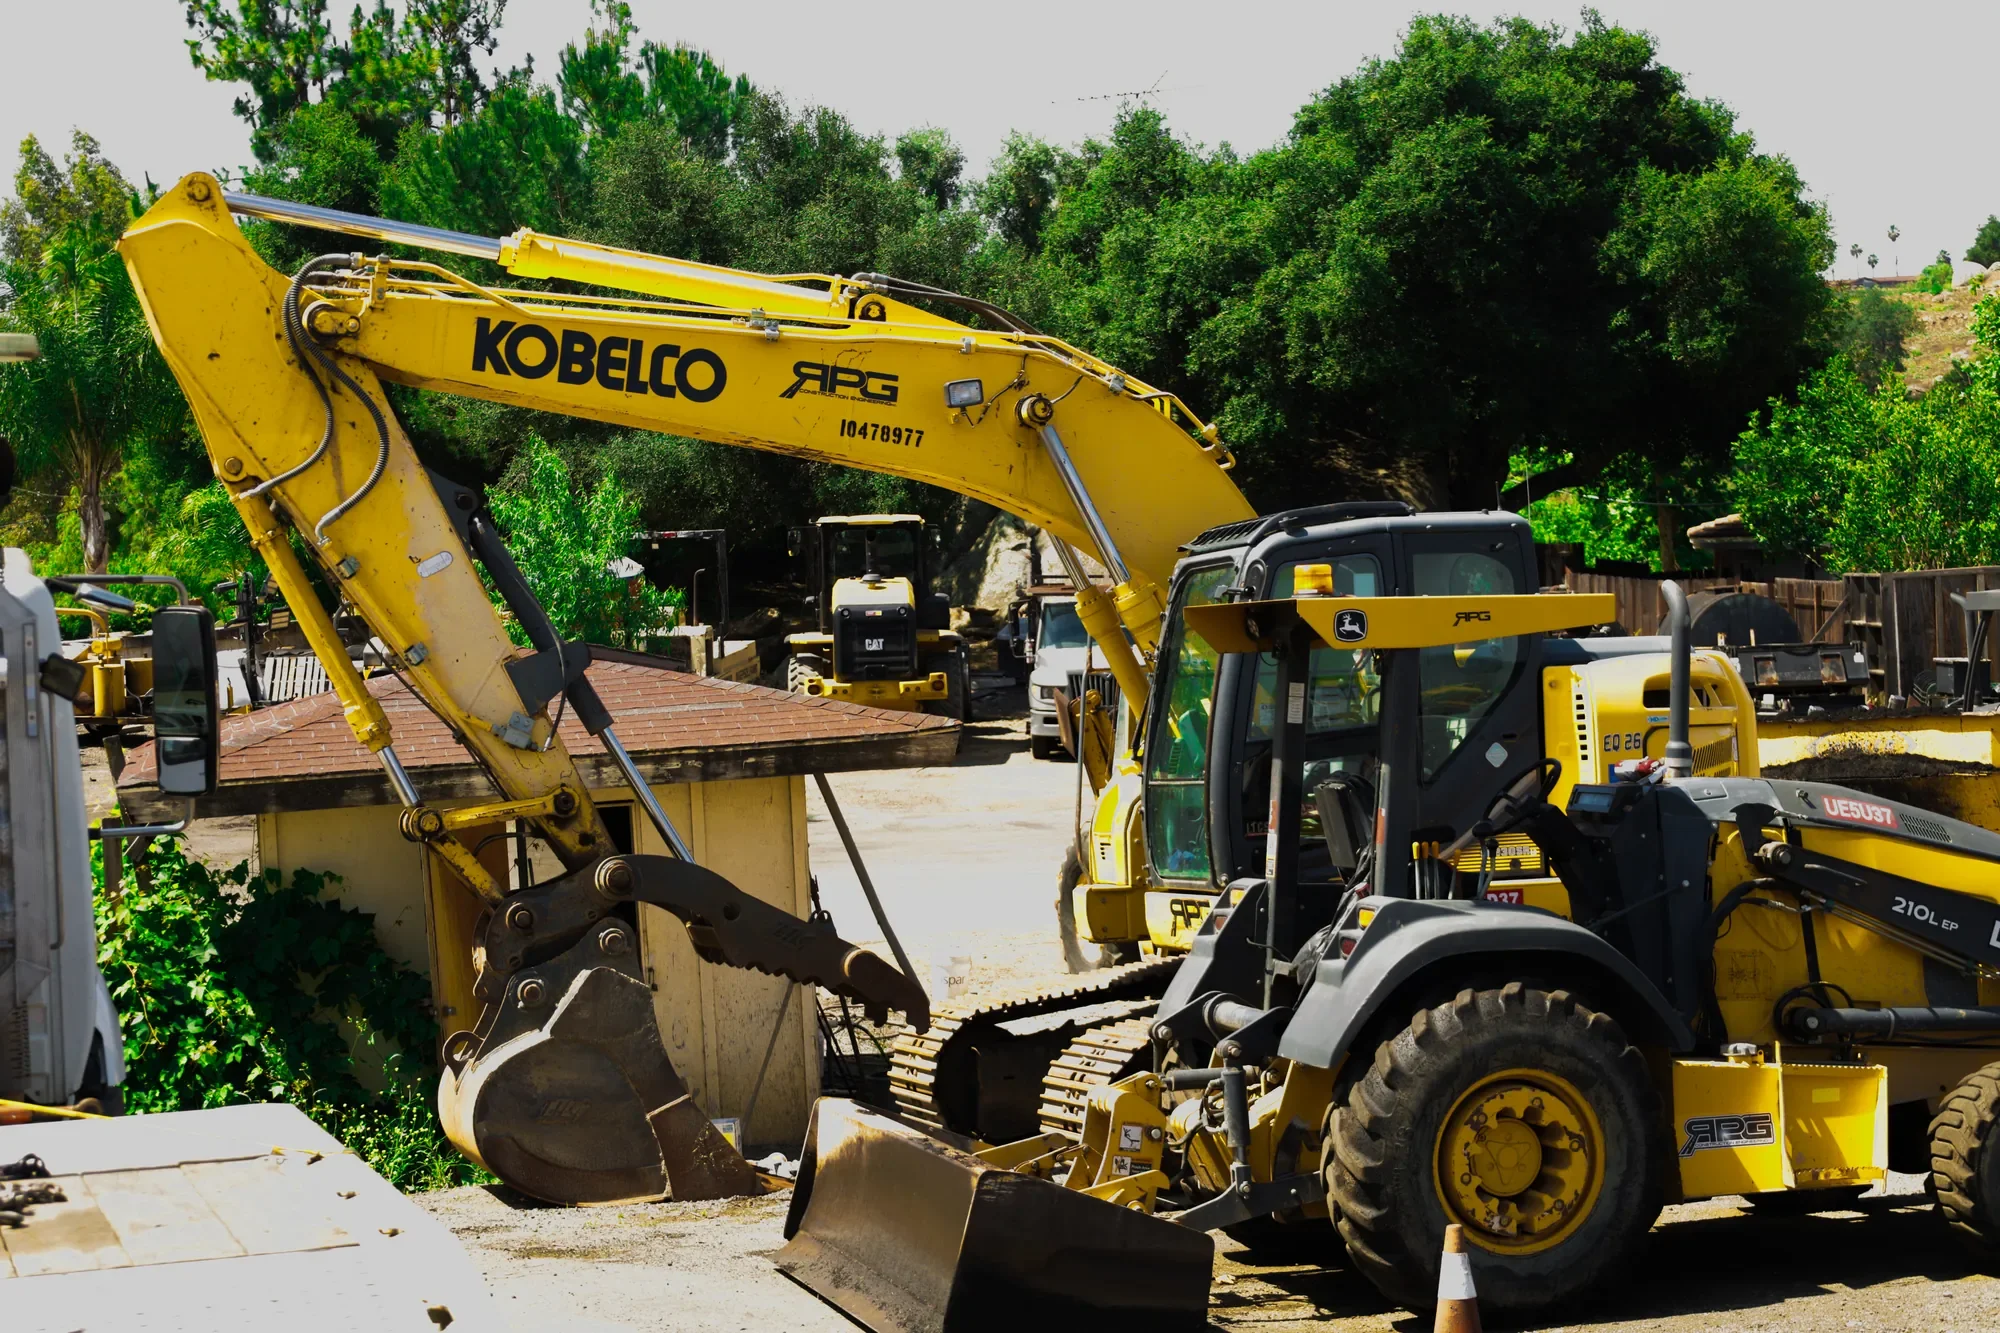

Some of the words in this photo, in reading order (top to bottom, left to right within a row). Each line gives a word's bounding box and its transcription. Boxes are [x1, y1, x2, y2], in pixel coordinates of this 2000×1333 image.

[472, 316, 728, 403] KOBELCO
[865, 638, 884, 651] CAT
[1603, 734, 1620, 752] EQ
[1823, 797, 1893, 825] UE5U37
[1891, 896, 1938, 926] 210L
[1941, 919, 1959, 931] EP
